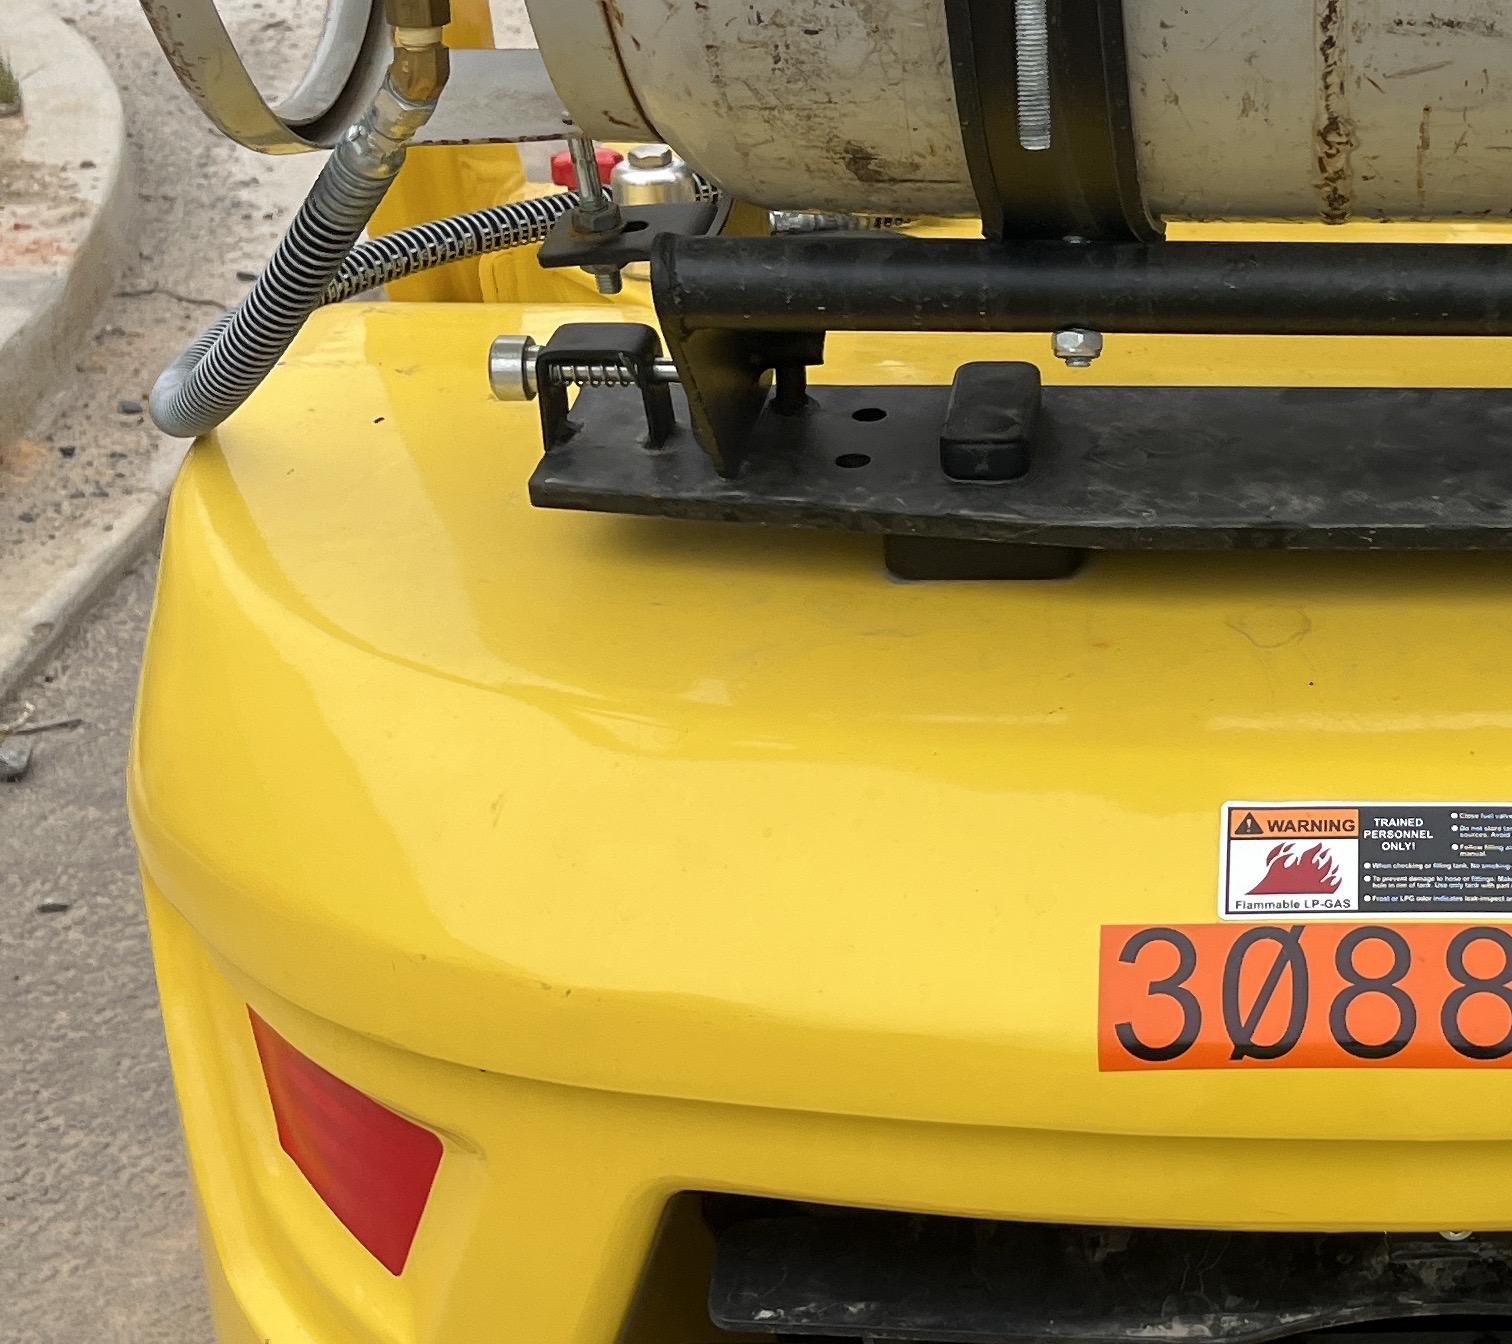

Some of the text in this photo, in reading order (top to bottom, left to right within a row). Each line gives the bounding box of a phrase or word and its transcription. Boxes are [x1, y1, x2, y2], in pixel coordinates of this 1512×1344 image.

[1267, 819, 1356, 833] WARNING
[1373, 817, 1424, 827] TRAINED
[1363, 830, 1434, 839] PERSONNEL
[1381, 841, 1416, 851] ONLY!
[1235, 899, 1350, 910] Flammable LP-GAS
